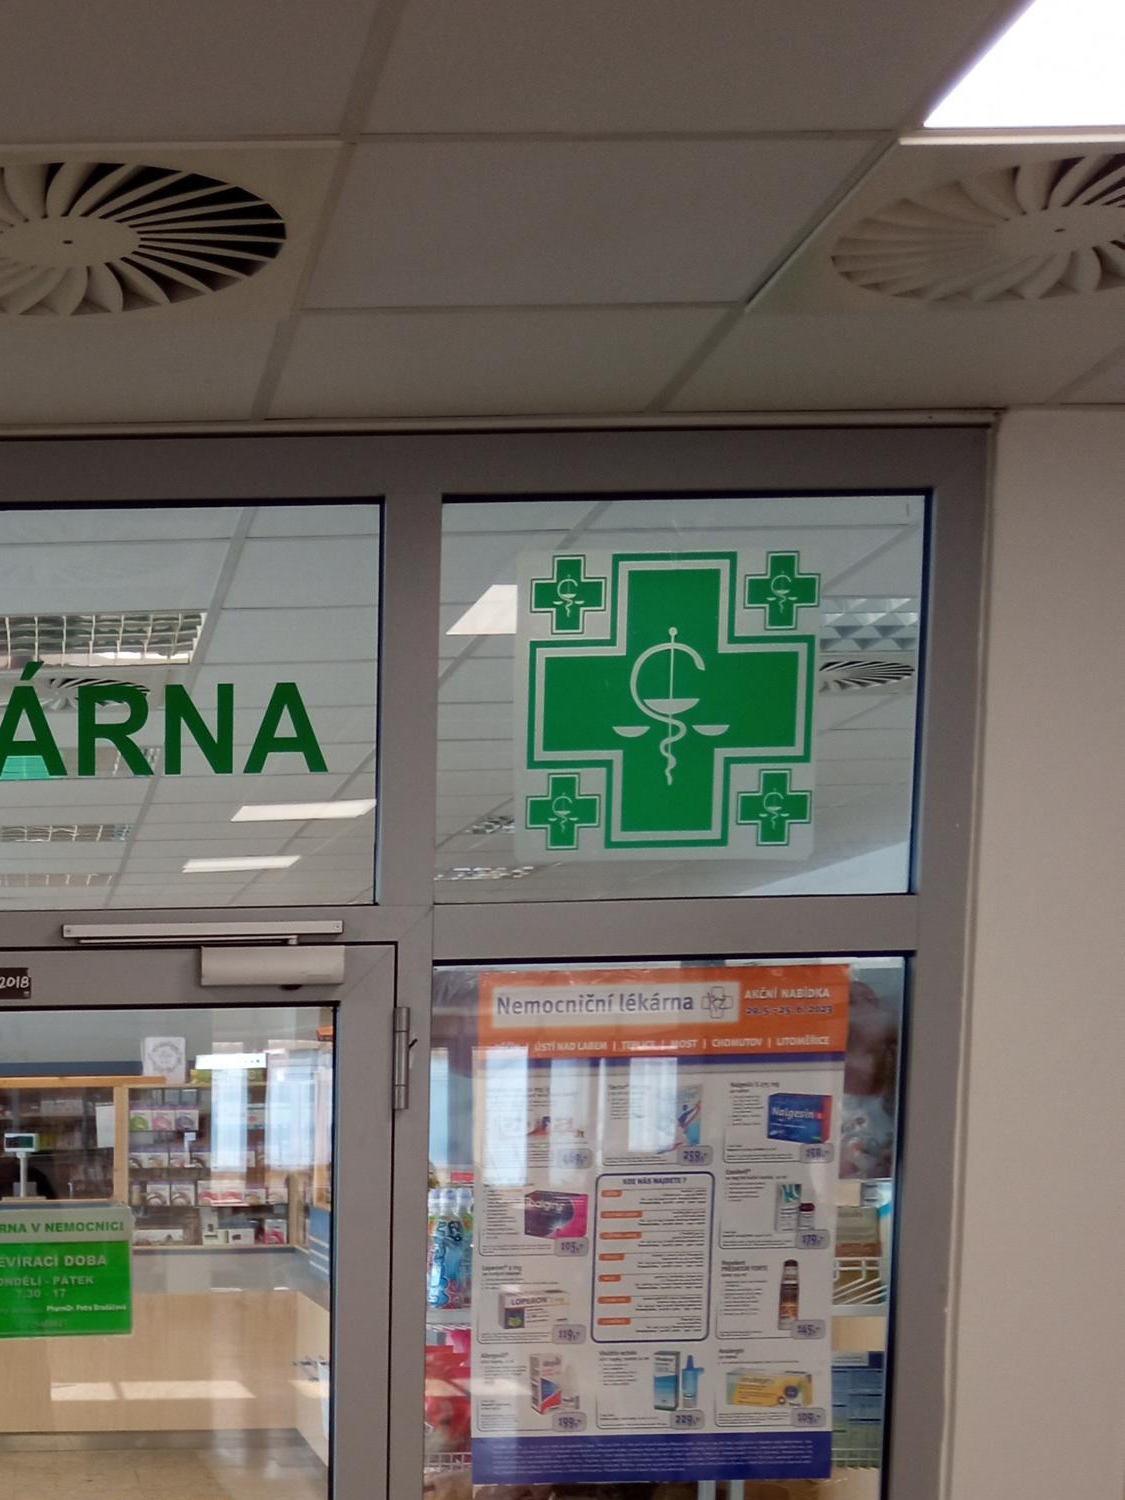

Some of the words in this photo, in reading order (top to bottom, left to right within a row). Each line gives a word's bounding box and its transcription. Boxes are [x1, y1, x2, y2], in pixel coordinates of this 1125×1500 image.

[781, 986, 831, 999] NABÍDKA
[496, 992, 614, 1016] Nemocniční
[619, 990, 695, 1013] lékárna
[31, 1223, 41, 1232] V
[45, 1221, 124, 1233] NEMOCNICI
[64, 1255, 108, 1267] DOBA
[53, 1274, 94, 1286] PÁTEK
[53, 1288, 67, 1298] 17
